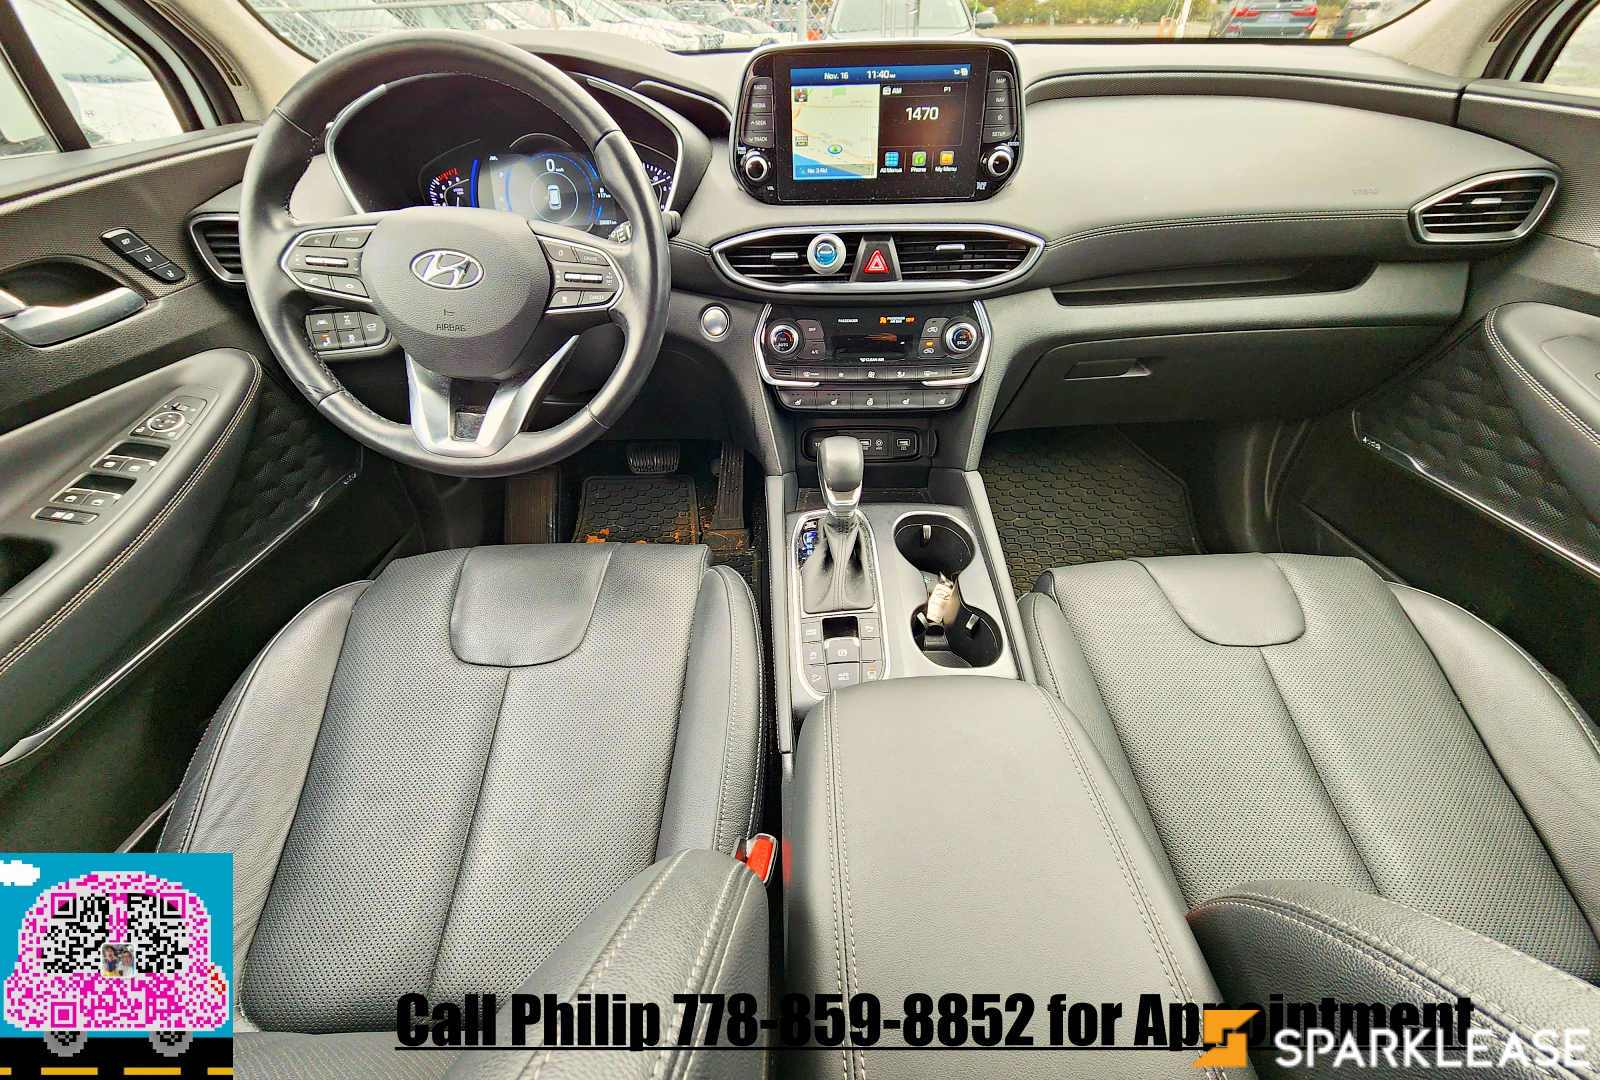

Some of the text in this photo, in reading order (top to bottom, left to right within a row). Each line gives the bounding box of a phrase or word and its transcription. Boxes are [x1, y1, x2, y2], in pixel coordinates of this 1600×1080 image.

[824, 71, 849, 80] Nov. 16
[866, 70, 889, 79] 11:40
[906, 107, 939, 121] 1470
[546, 158, 555, 172] 0
[436, 323, 465, 332] AIRBAG
